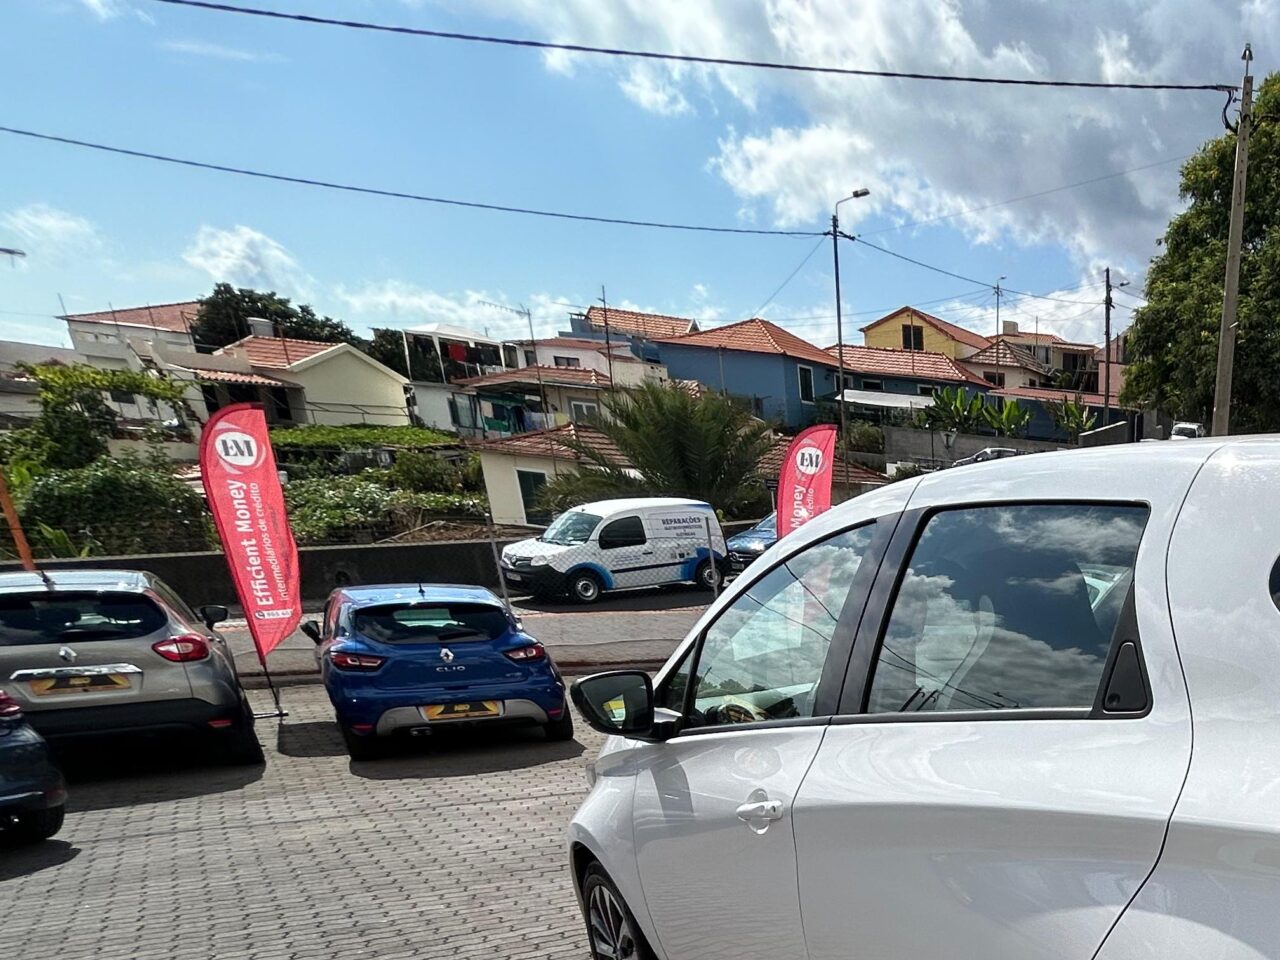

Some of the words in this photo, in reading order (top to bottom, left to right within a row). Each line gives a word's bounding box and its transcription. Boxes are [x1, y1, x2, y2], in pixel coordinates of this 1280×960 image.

[220, 439, 254, 457] EM
[800, 452, 820, 468] EM
[226, 480, 254, 533] Money
[249, 482, 264, 517] crédito
[790, 485, 807, 528] Money
[257, 519, 268, 532] de
[241, 538, 274, 606] Efficient
